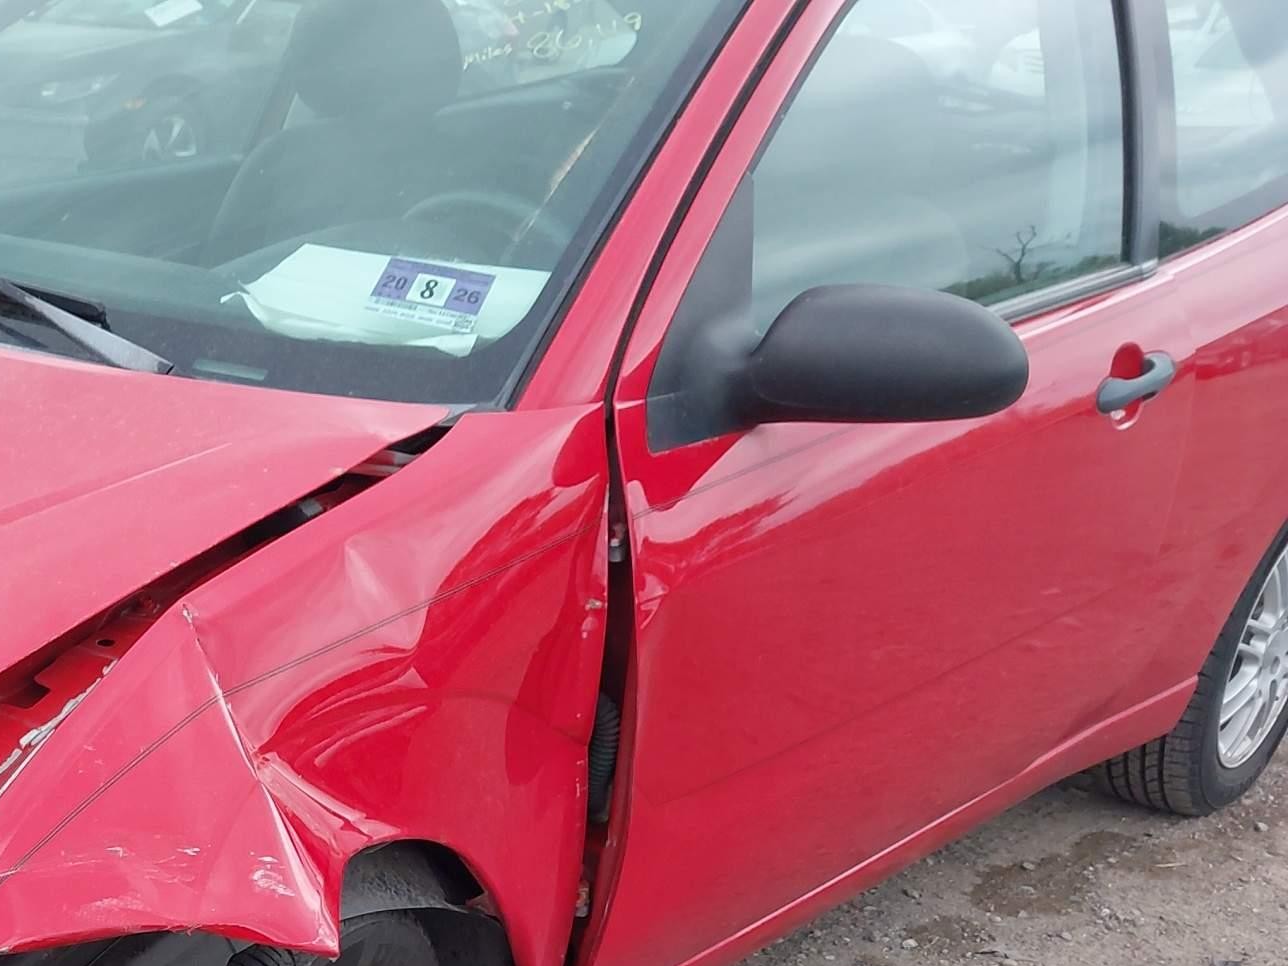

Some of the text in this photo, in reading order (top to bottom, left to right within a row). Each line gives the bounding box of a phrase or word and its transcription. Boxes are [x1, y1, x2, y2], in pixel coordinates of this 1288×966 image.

[381, 274, 481, 305] 20 8 26
